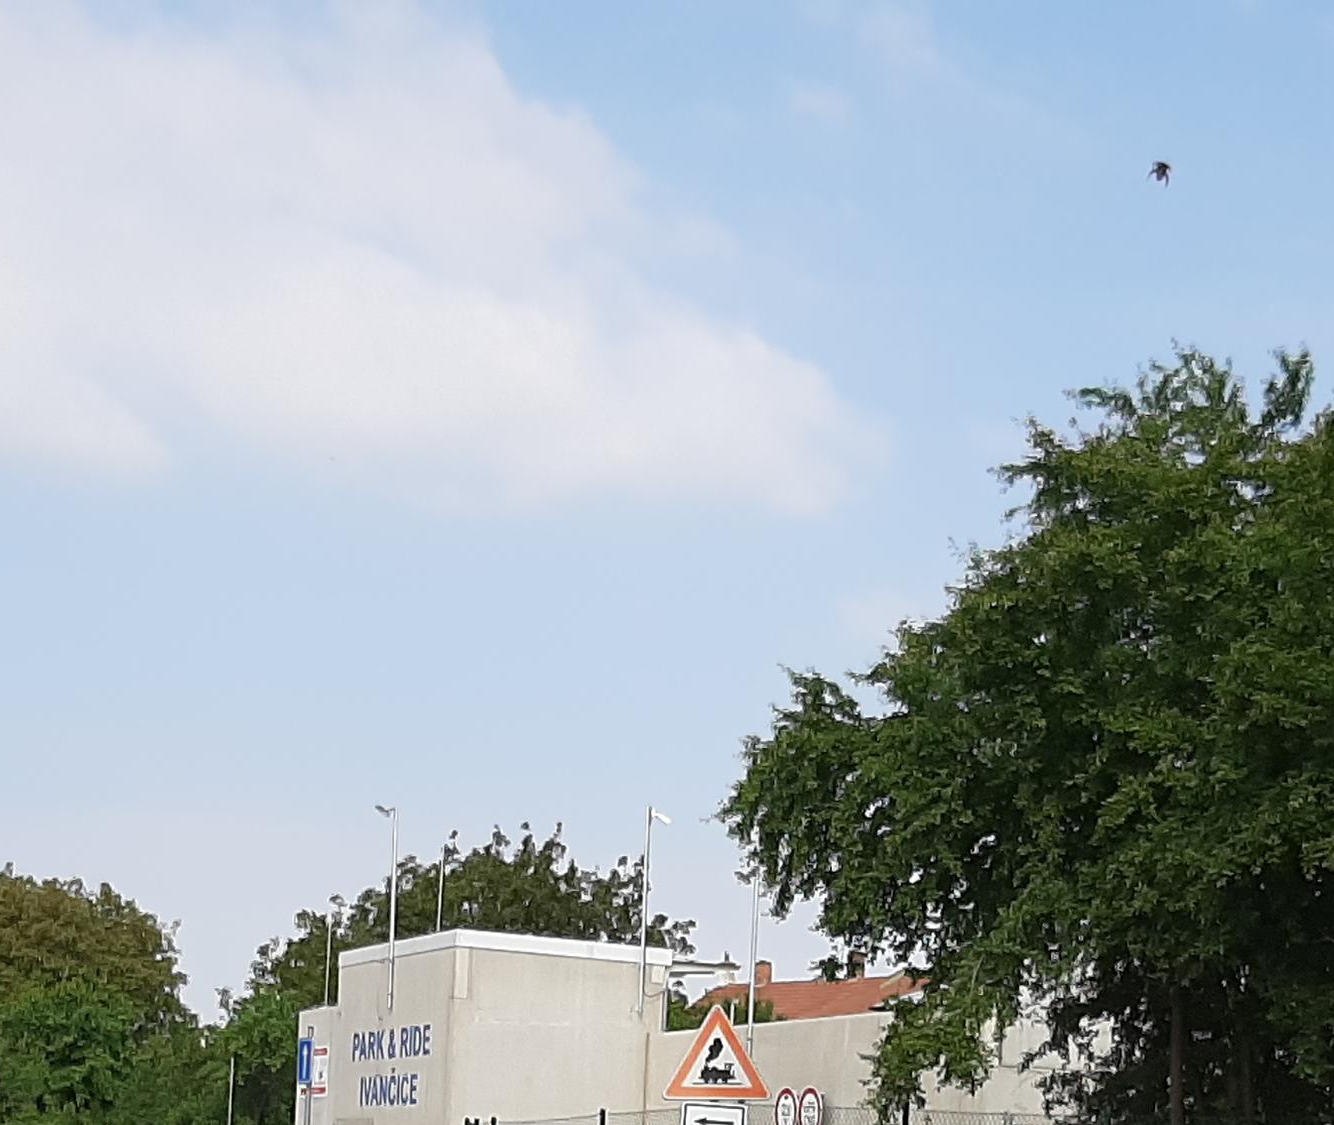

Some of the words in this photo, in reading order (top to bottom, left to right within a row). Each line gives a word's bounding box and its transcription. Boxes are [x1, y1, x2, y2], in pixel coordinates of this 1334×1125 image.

[352, 1030, 385, 1062] PARK
[388, 1028, 396, 1059] &
[400, 1024, 431, 1058] RIDE
[359, 1067, 418, 1107] IVANČICE
